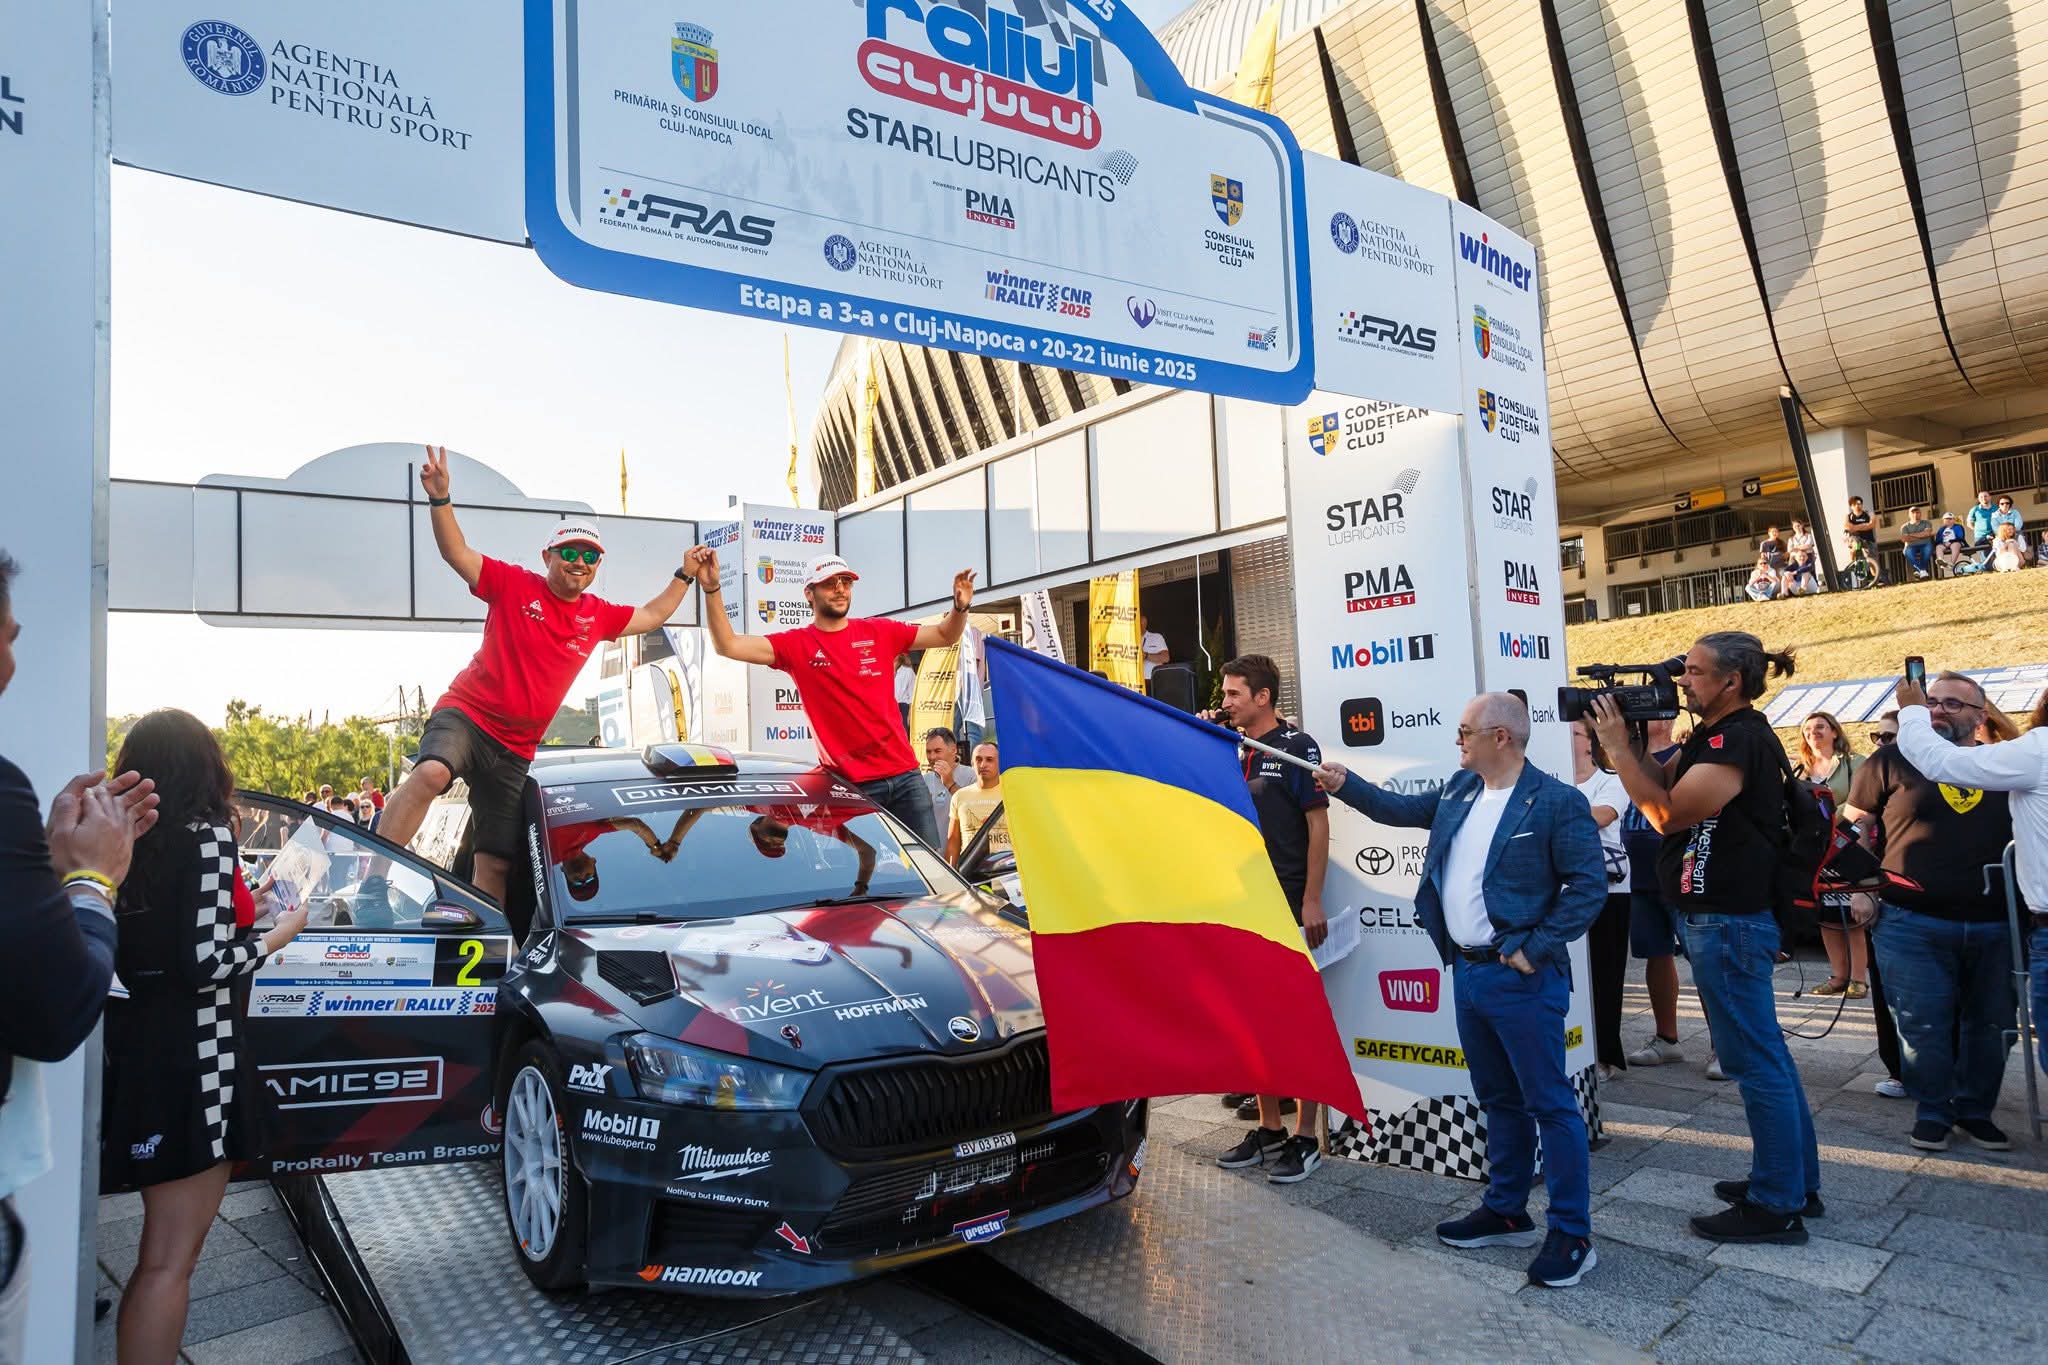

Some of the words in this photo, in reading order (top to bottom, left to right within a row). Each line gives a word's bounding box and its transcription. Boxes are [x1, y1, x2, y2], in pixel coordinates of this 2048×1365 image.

[271, 40, 399, 88] AGENȚIA
[271, 61, 436, 120] NAȚIONALĂ
[271, 86, 382, 130] PENTRU
[390, 115, 473, 151] SPORT
[614, 89, 668, 114] PRIMĂRIA
[671, 104, 682, 118] ȘI
[684, 108, 739, 132] CONSILIUL
[741, 123, 773, 140] LOCAL
[660, 118, 733, 145] CLUJ-NAPOCA
[847, 108, 1116, 202] STARLUBRICANTS
[966, 189, 1015, 219] PMA
[637, 194, 776, 247] FRAS
[686, 235, 739, 251] AUTOMOBILISM
[741, 246, 768, 256] SPORTIV
[1204, 229, 1254, 250] CONSILIUL
[1219, 254, 1243, 268] CLUJ
[1361, 246, 1402, 267] PENTRU
[1403, 258, 1434, 275] SPORT
[1460, 232, 1531, 292] winner
[859, 265, 905, 283] PENTRU
[907, 274, 944, 290] SPORT
[986, 269, 1046, 293] winner
[1061, 286, 1093, 306] CNR
[995, 286, 1046, 310] RALLY
[1059, 301, 1092, 319] 2025
[740, 283, 811, 320] Etapa
[818, 301, 833, 320] a
[839, 301, 874, 327] 3-a
[894, 312, 1025, 354] Cluj-Napoca
[1042, 337, 1095, 366] 20-22
[1101, 346, 1149, 374] iunie
[1155, 357, 1197, 382] 2025
[1359, 314, 1436, 352] FRAS
[1345, 401, 1402, 419] CONSI
[1498, 396, 1538, 421] CONSILIUL
[1347, 431, 1385, 450] CLUJ
[1500, 426, 1520, 443] CLUJ
[1326, 493, 1404, 531] STAR
[1492, 486, 1532, 521] STAR
[727, 532, 739, 543] 2025
[728, 522, 740, 533] CNR
[753, 518, 793, 530] winner
[803, 524, 825, 535] CNR
[760, 530, 792, 541] RALLY
[802, 534, 824, 544] 2025
[1328, 520, 1406, 546] LUBRICANTS
[1493, 518, 1534, 536] LUBRICANTS
[1344, 564, 1414, 599] PMA
[1504, 560, 1538, 590] PMA
[1331, 638, 1403, 669] Mobil
[1500, 632, 1536, 659] Mobil
[776, 689, 800, 702] PM
[1348, 711, 1375, 733] tbi
[1391, 707, 1441, 728] bank
[1532, 706, 1555, 723] bank
[766, 727, 805, 740] Mobil
[1262, 761, 1282, 770] BYBIT
[626, 783, 793, 800] DINAMIC92
[1693, 819, 1718, 894] livestream
[457, 940, 484, 986] 2
[266, 994, 306, 1002] FRAS
[325, 995, 396, 1011] winner
[405, 998, 456, 1011] RALLY
[475, 993, 496, 1003] CN
[1387, 979, 1431, 1004] VIVO!
[834, 996, 927, 1021] HOFFMAN
[583, 1108, 638, 1135] Mobil
[581, 1131, 656, 1151] www.lubexpert.ro
[960, 1142, 976, 1156] BV
[979, 1138, 992, 1151] 03
[994, 1133, 1014, 1148] PRT
[272, 1151, 363, 1173] ProRally
[369, 1151, 426, 1164] Team
[433, 1142, 501, 1159] Brasov
[677, 1143, 770, 1171] Milwaukee
[666, 1186, 696, 1199] Nothing
[698, 1191, 711, 1200] but
[712, 1194, 743, 1204] HEAVY
[965, 1220, 1001, 1241] presto
